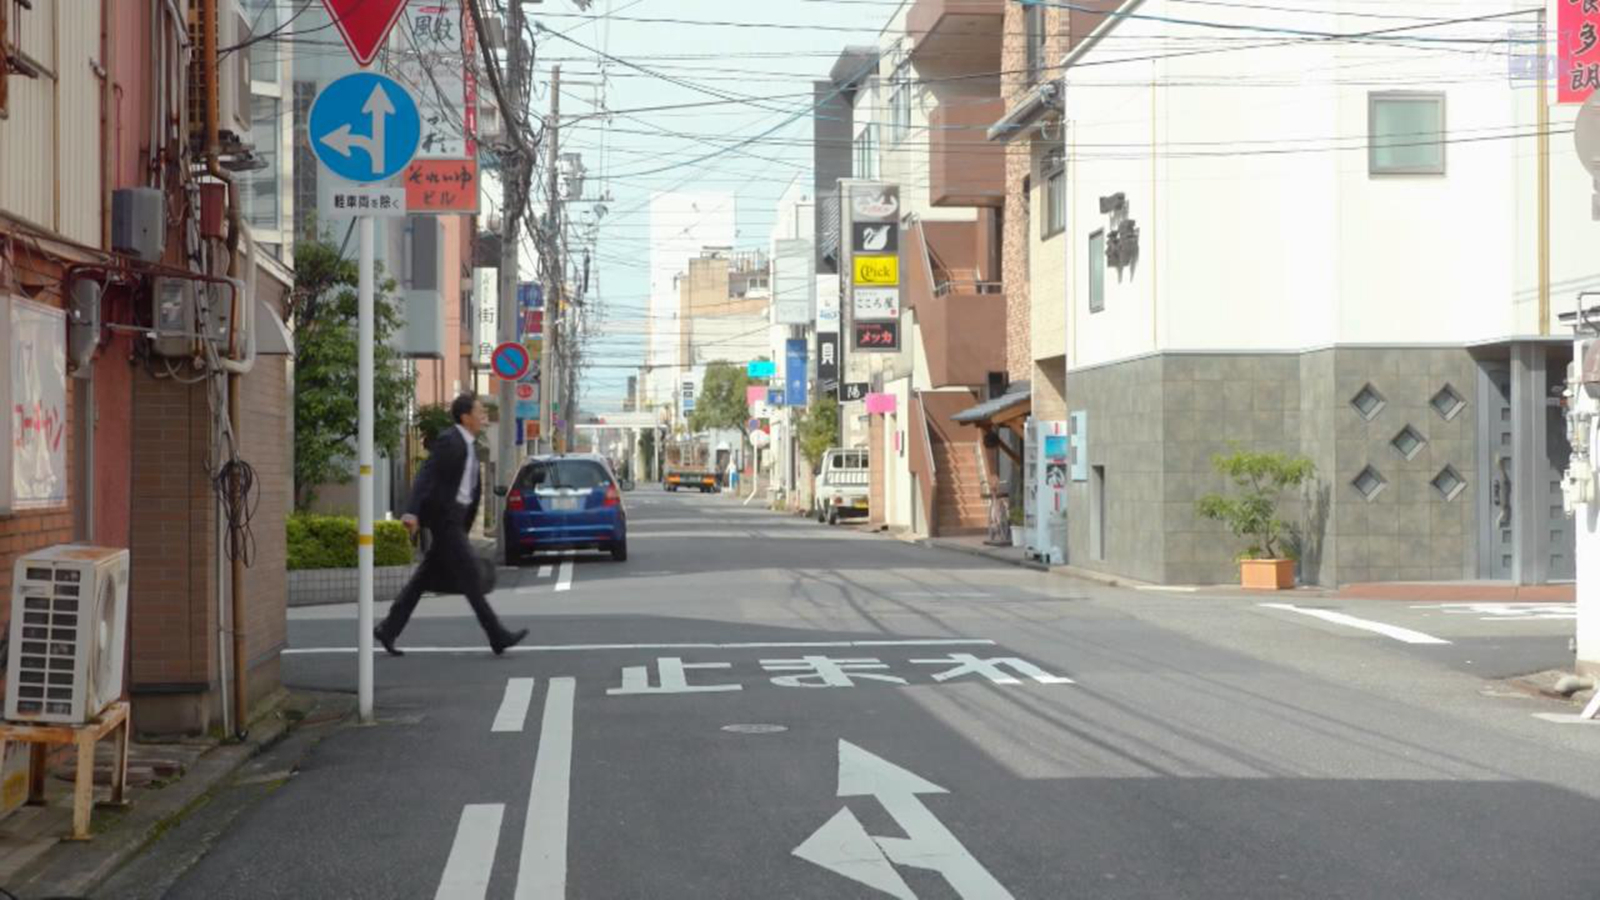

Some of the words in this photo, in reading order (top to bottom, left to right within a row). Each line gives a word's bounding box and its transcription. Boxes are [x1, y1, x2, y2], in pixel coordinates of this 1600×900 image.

[334, 194, 400, 209] 軽車両を除く
[423, 191, 456, 205] ビル
[860, 330, 893, 344] メッカ
[606, 654, 1076, 695] 止まれ
